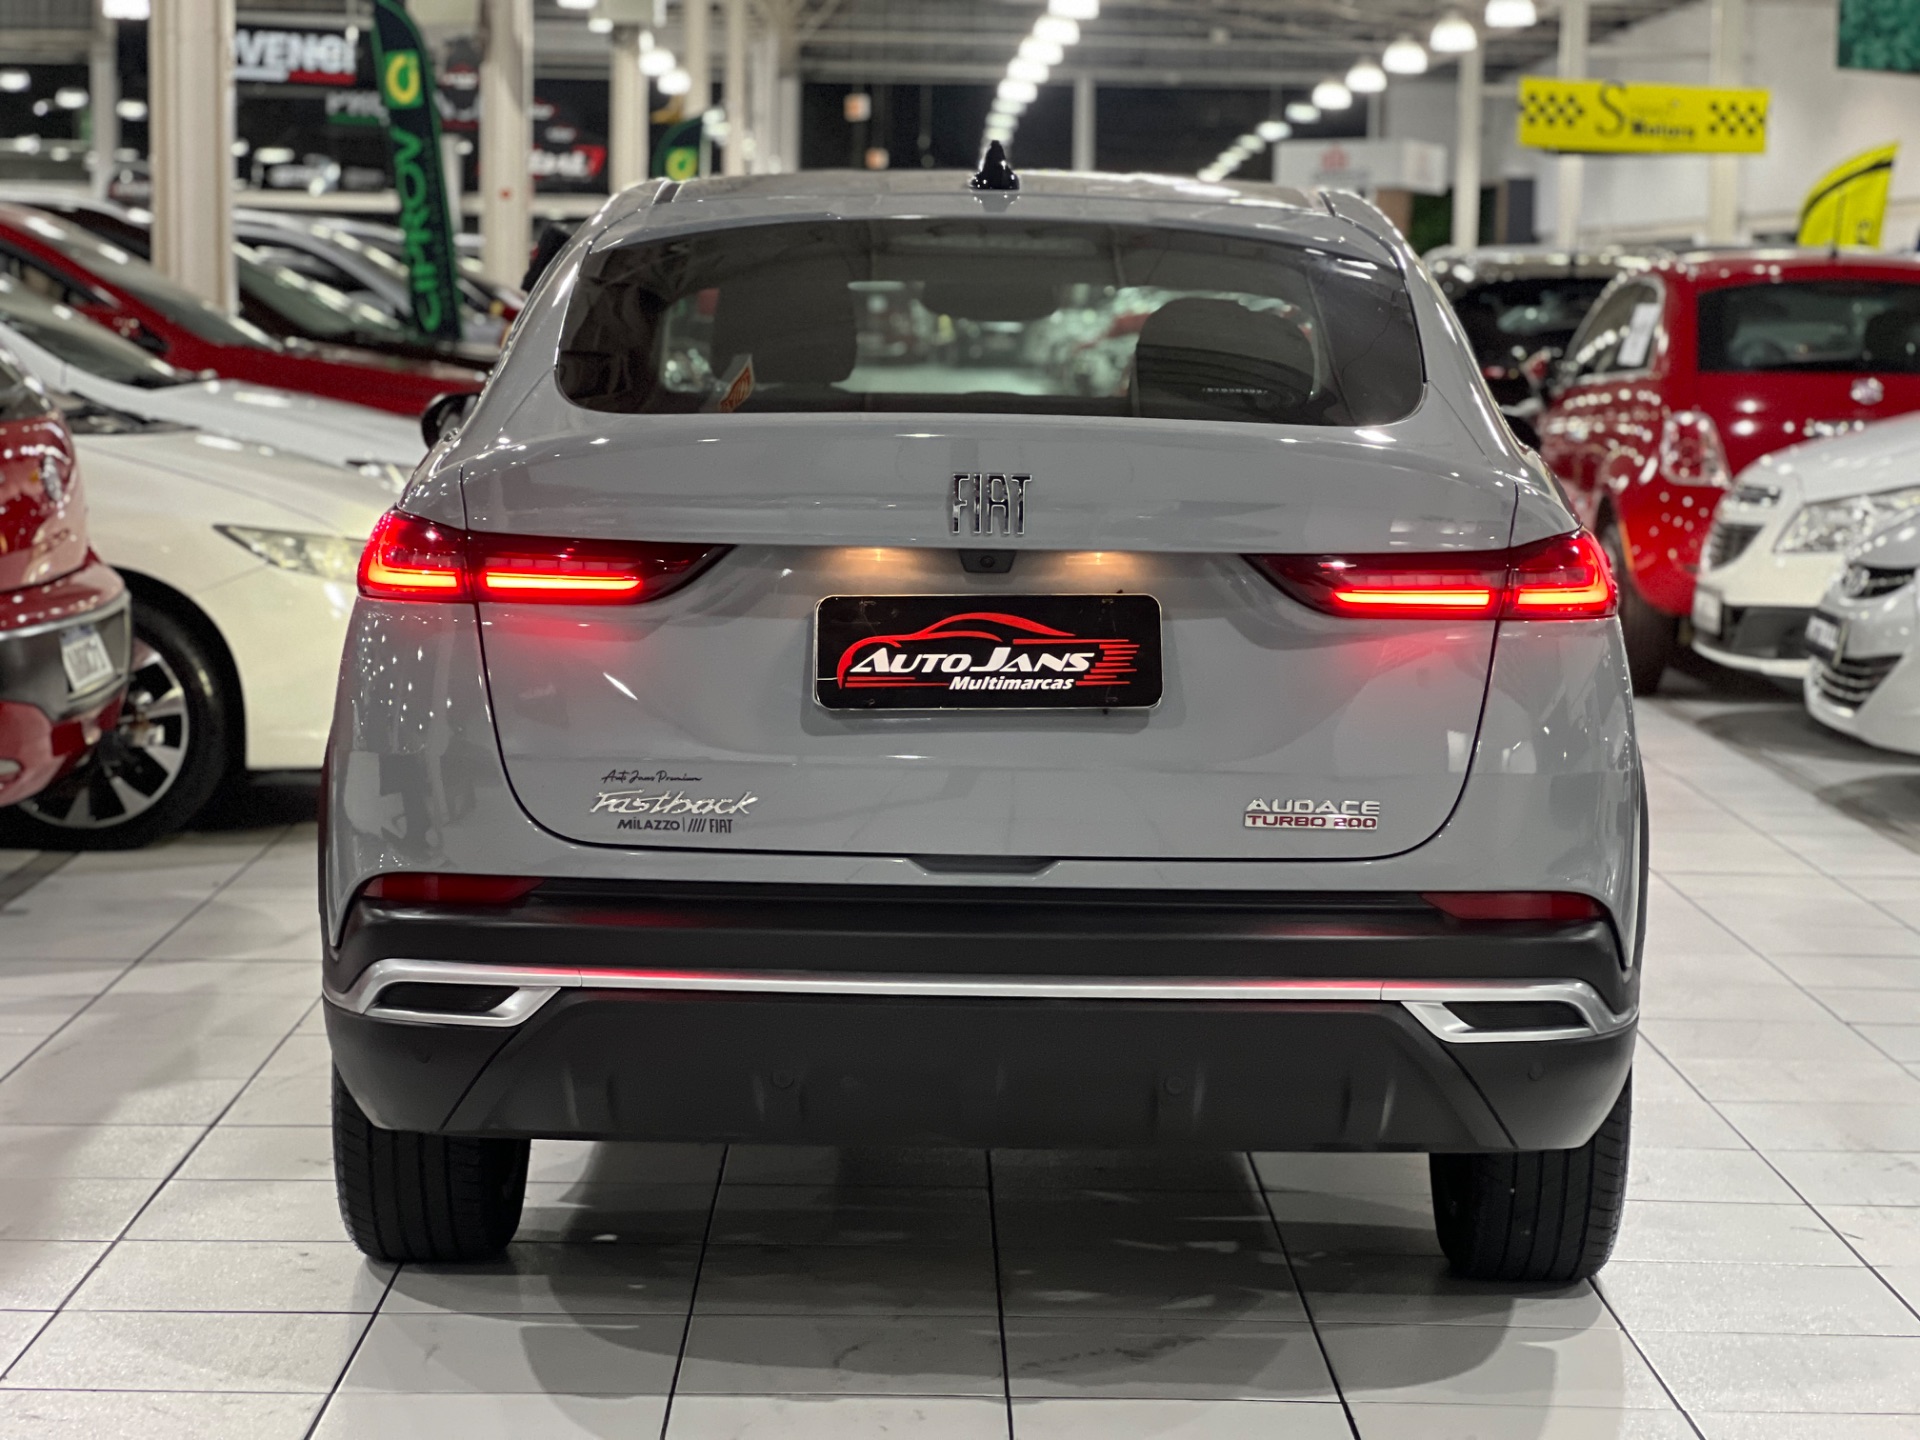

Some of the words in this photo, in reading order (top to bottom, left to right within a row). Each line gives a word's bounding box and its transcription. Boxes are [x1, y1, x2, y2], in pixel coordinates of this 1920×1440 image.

[952, 473, 1032, 535] FIAT
[849, 647, 971, 673] AUTO
[967, 647, 1095, 673] JANS
[949, 675, 1075, 692] Multimarcas
[655, 770, 703, 783] Premium
[590, 788, 758, 815] Fastback
[1246, 798, 1380, 815] AUDACE
[709, 818, 733, 833] FIAT
[1247, 815, 1327, 828] TURBO
[1333, 817, 1377, 829] 200
